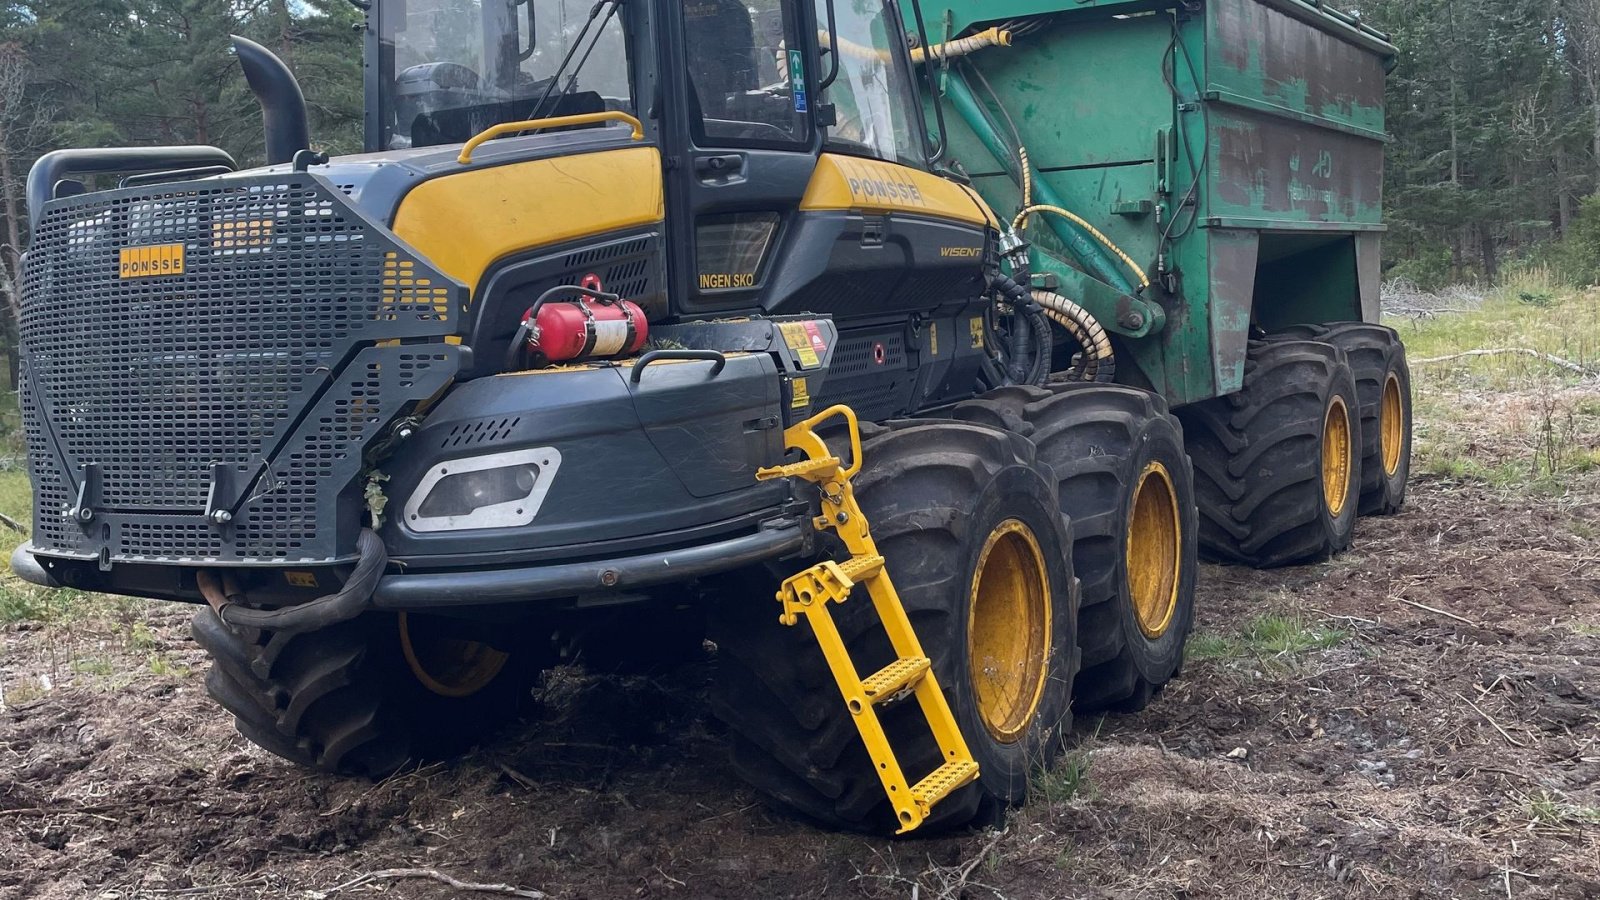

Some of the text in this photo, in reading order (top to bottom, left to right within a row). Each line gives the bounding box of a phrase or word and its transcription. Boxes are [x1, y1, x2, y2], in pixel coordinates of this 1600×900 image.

[849, 178, 921, 201] PONSSE
[940, 247, 983, 257] WISENT
[122, 258, 181, 274] PONSSE
[699, 273, 754, 289] INGEN SKO
